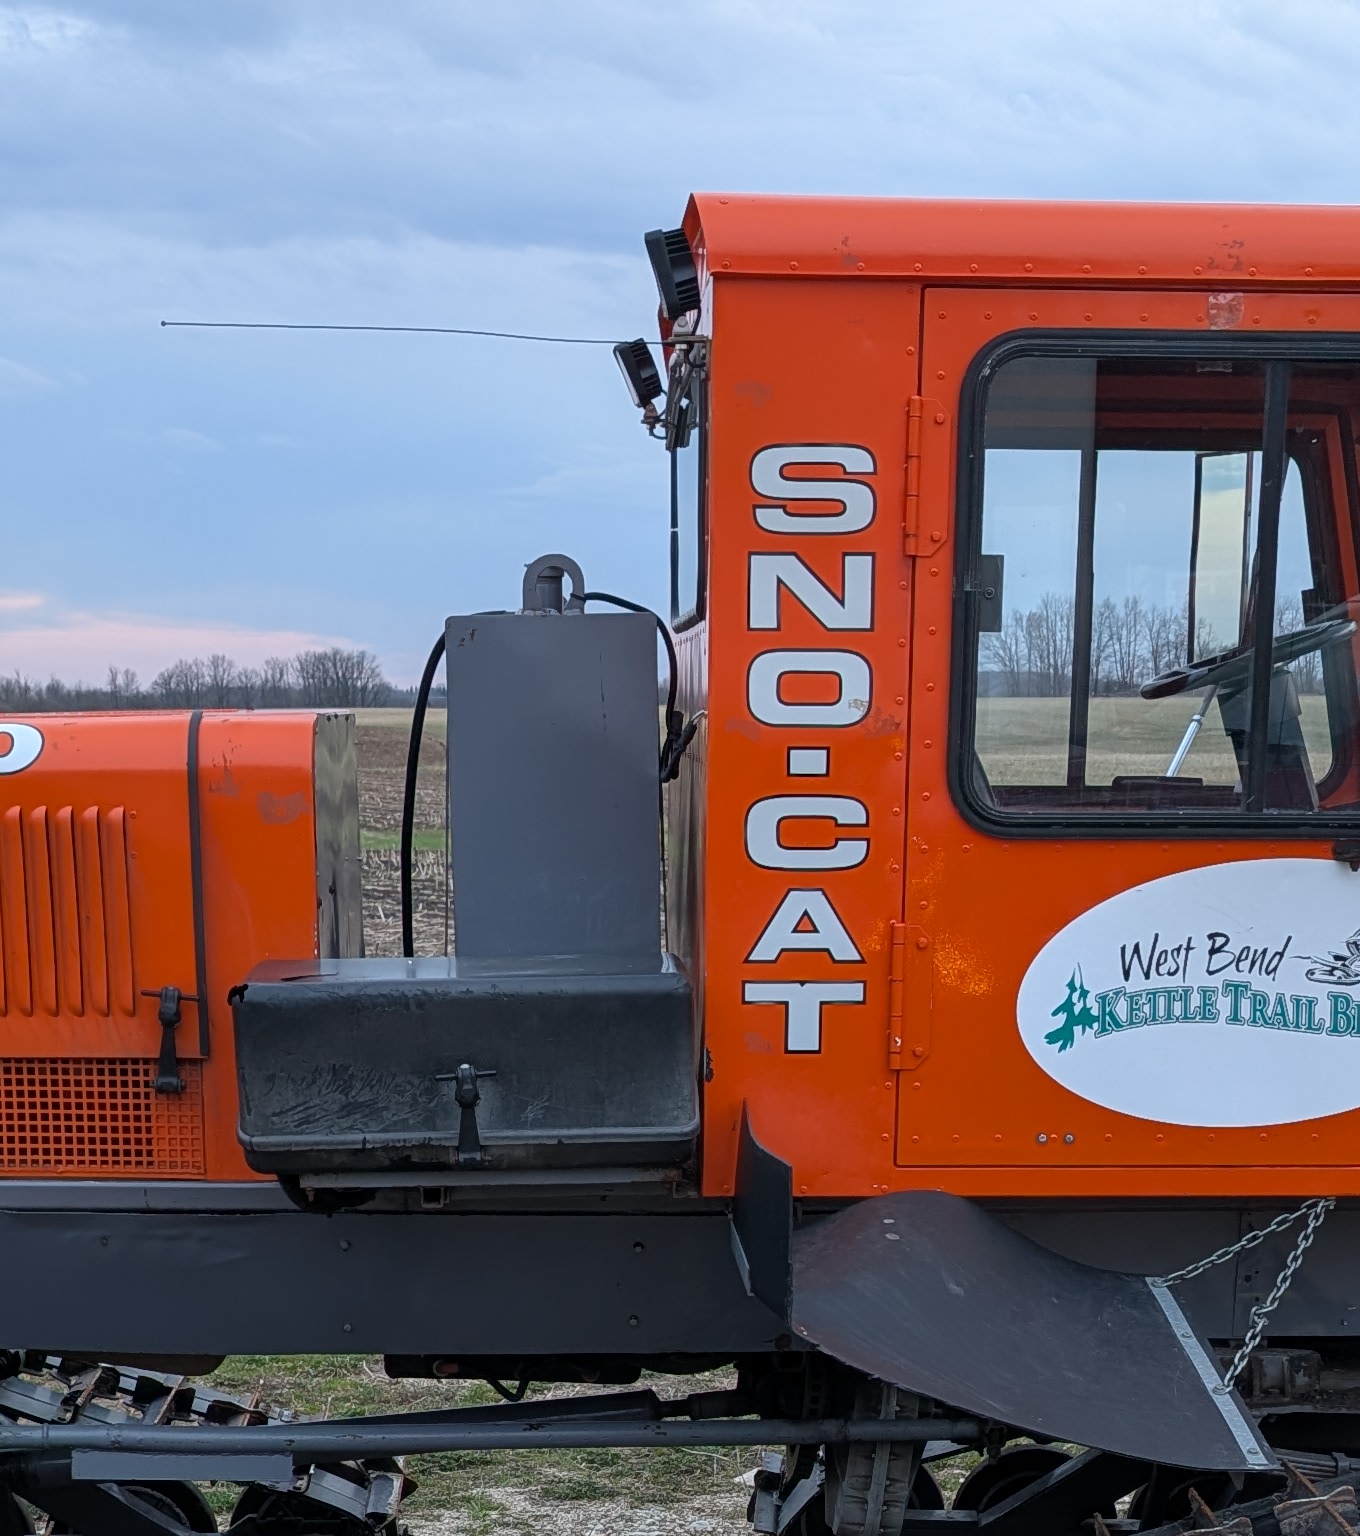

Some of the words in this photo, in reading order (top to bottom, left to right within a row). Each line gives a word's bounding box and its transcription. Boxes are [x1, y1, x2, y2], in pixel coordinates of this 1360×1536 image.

[1119, 932, 1197, 984] West
[1205, 931, 1293, 982] Bend
[1093, 983, 1221, 1039] KETTLE
[1221, 979, 1328, 1035] TRAIL
